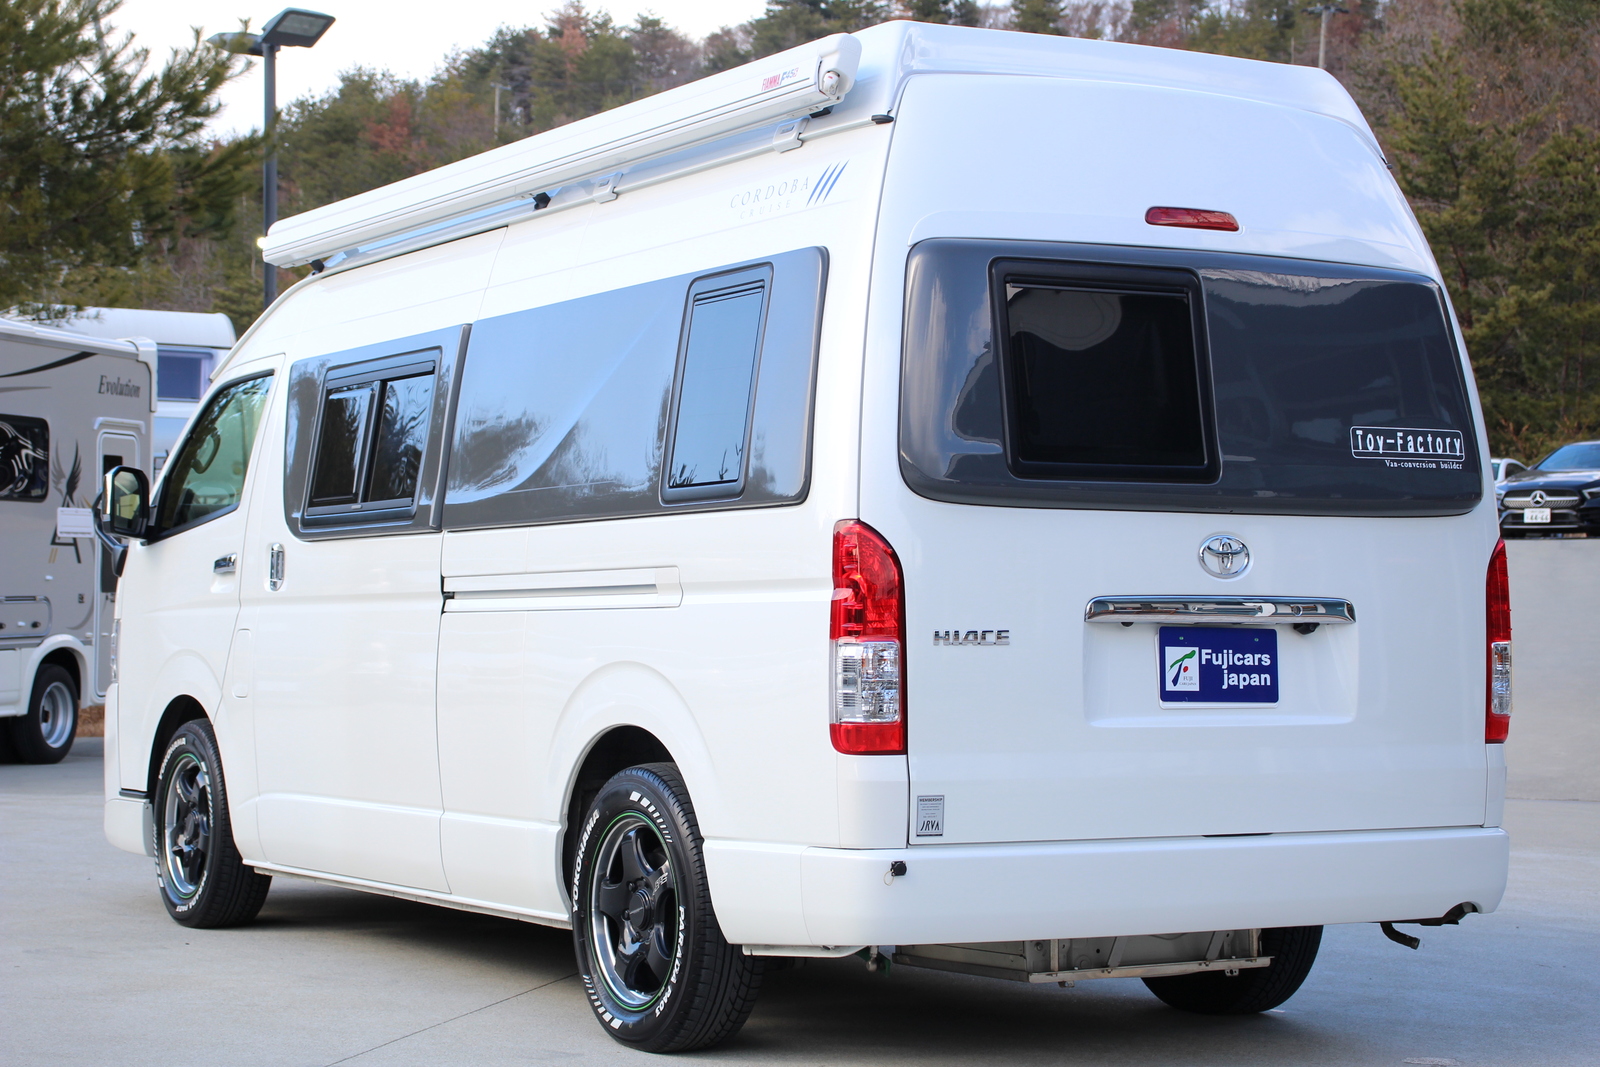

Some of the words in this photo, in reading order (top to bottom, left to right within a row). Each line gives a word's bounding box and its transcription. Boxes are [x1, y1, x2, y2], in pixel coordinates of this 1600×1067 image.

[730, 176, 809, 209] CORDOBA
[98, 374, 141, 398] Evolution
[1355, 430, 1461, 456] Toy-Factory
[1384, 459, 1437, 469] Van-conversion
[1439, 461, 1463, 470] builder
[933, 629, 1010, 646] HIACE
[1201, 648, 1271, 669] Fujicars
[1222, 670, 1271, 689] japan
[572, 808, 600, 913] YOKOHAMA
[670, 905, 686, 984] PARADA
